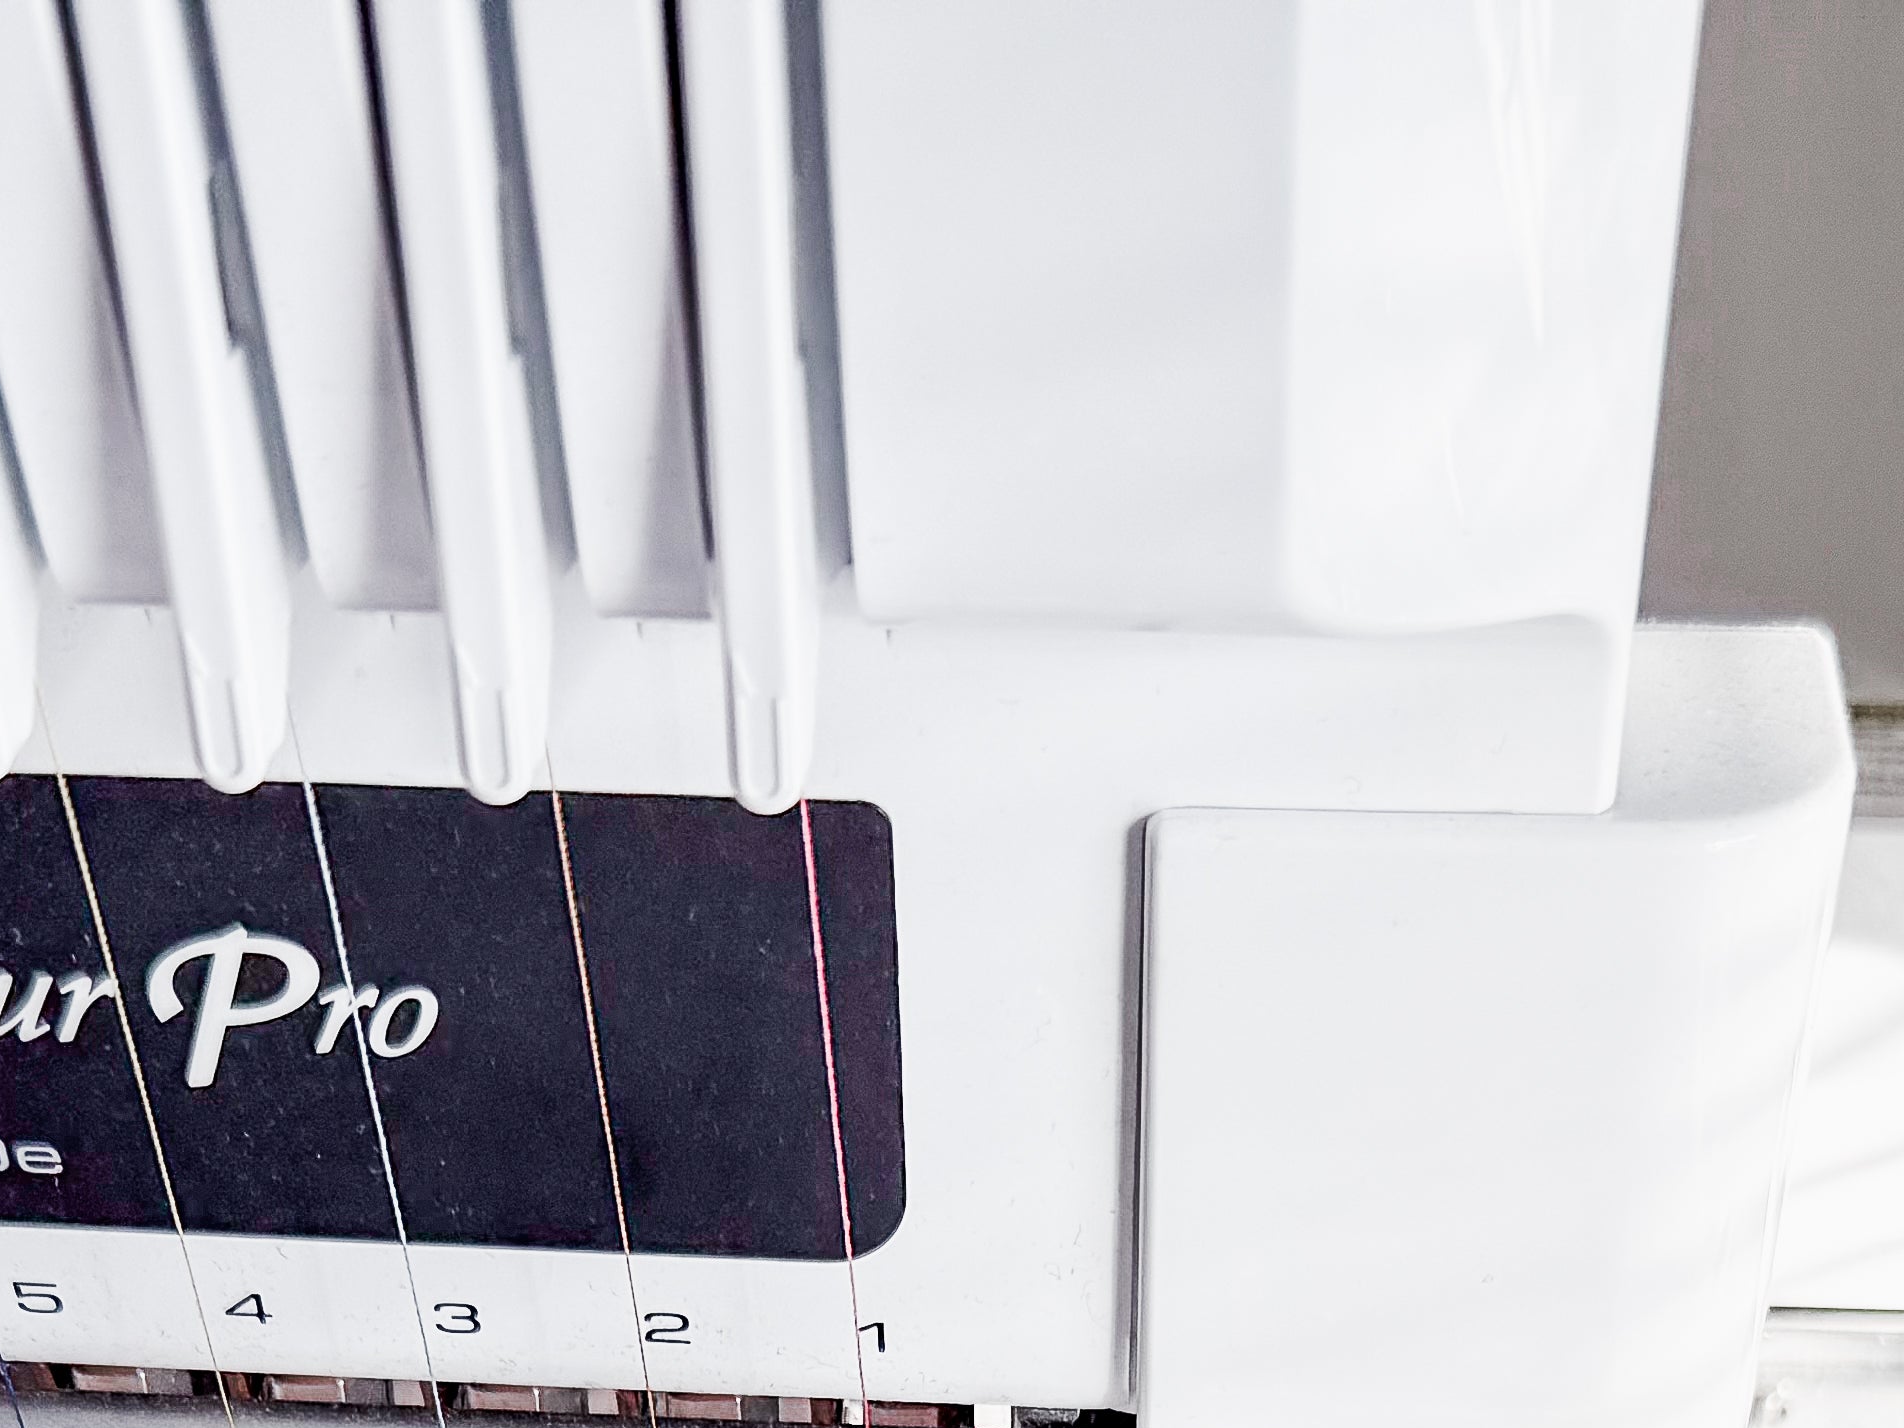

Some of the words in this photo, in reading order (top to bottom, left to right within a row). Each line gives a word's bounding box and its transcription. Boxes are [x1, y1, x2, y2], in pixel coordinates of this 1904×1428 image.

[149, 923, 439, 1089] Pro
[12, 1281, 64, 1315] 5
[225, 1292, 273, 1326] 4
[434, 1302, 481, 1335] 3
[644, 1312, 691, 1346] 2
[858, 1322, 887, 1353] 1
